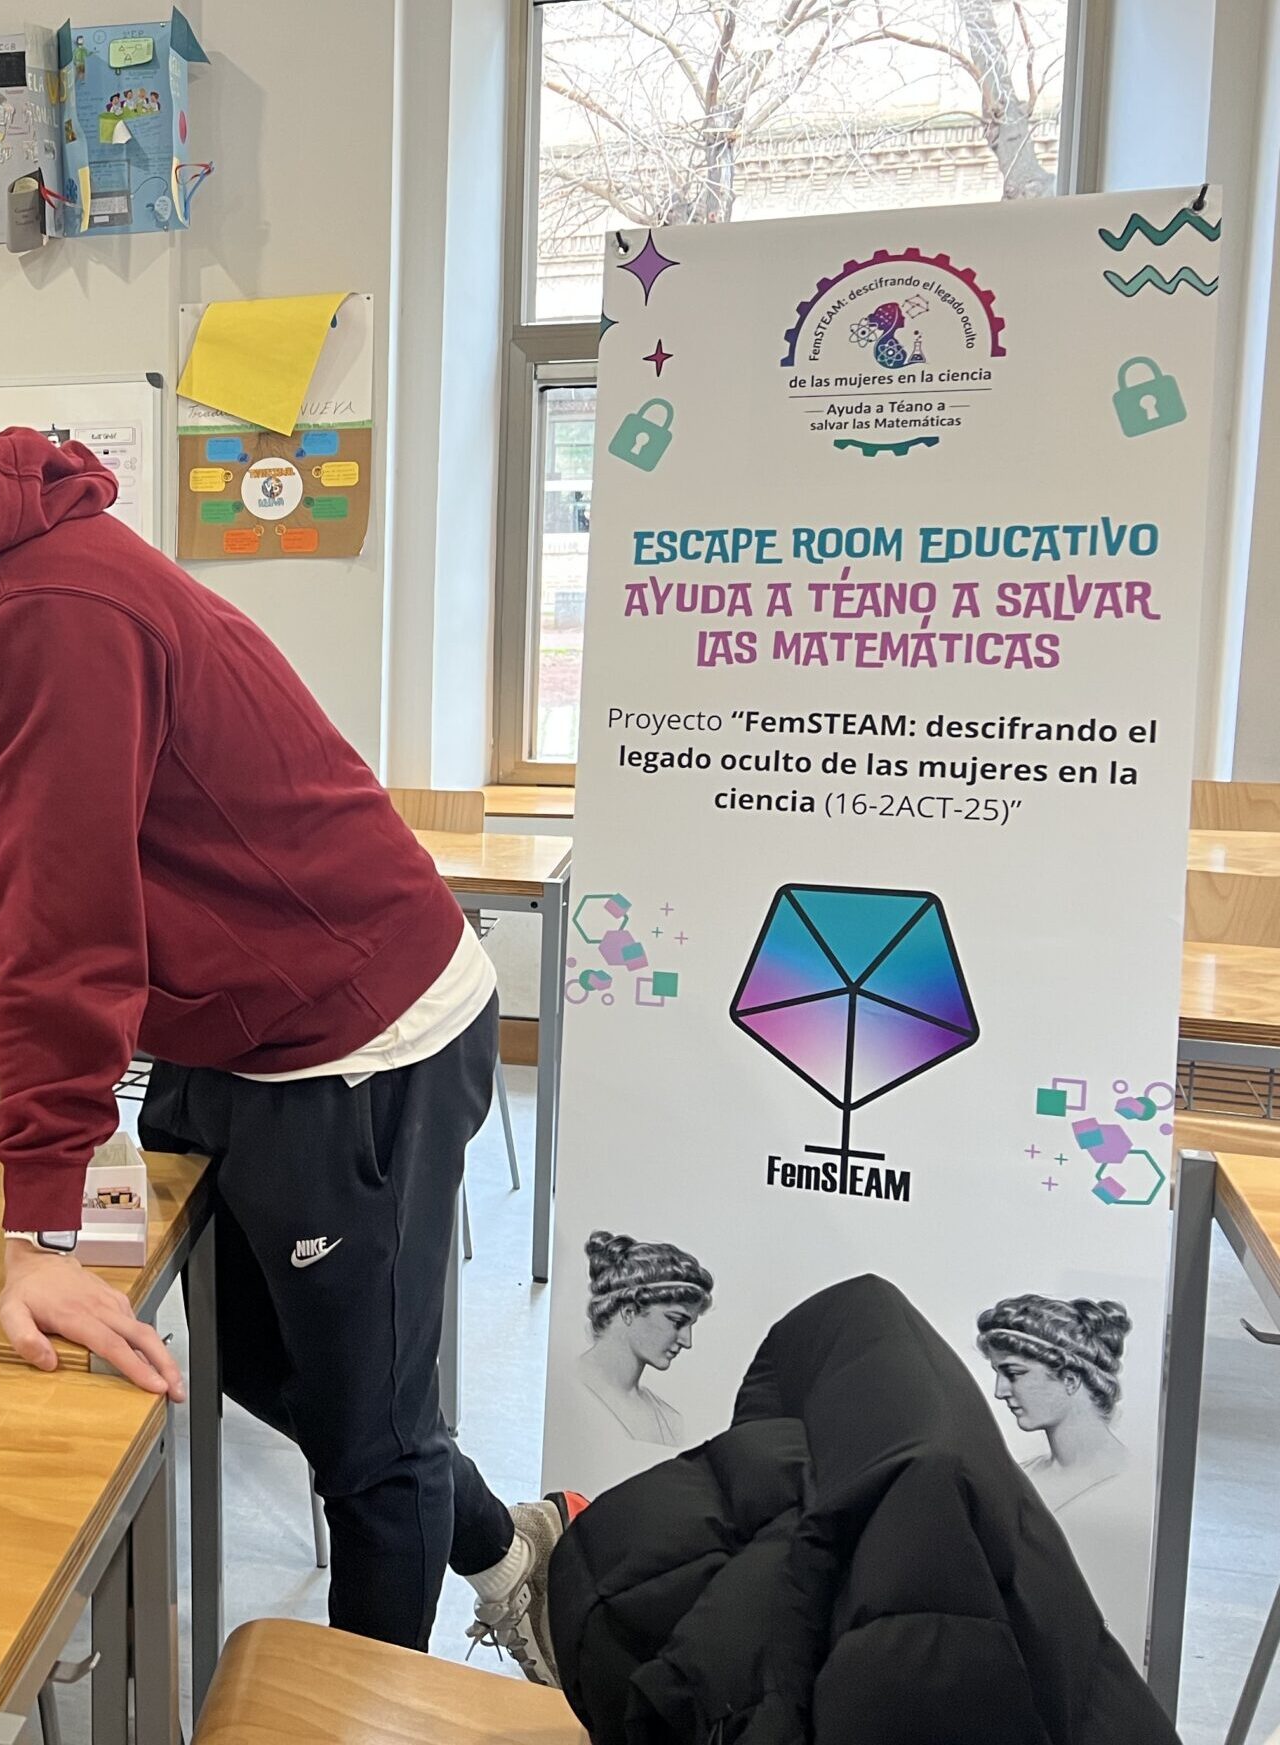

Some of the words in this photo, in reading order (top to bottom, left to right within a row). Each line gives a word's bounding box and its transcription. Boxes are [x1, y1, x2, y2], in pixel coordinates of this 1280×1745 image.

[808, 298, 849, 362] FemSTEAM:
[849, 275, 920, 301] descifrando
[922, 281, 934, 291] el
[934, 284, 964, 315] legado
[960, 315, 978, 349] oculto
[789, 376, 807, 389] de
[810, 375, 830, 388] las
[834, 374, 894, 389] mujeres
[898, 372, 917, 384] en
[921, 370, 934, 383] la
[938, 367, 992, 383] ciencia
[810, 418, 849, 431] salvar
[852, 418, 871, 430] las
[874, 414, 962, 429] Matemáticas
[826, 402, 871, 418] Ayuda
[875, 404, 884, 414] a
[888, 399, 933, 413] Téano
[937, 402, 946, 412] a
[633, 528, 783, 565] ESCAPE
[792, 527, 903, 564] ROOM
[919, 516, 1159, 563] EDUCATIVO
[624, 576, 753, 617] AYUDA
[766, 582, 793, 618] A
[808, 566, 937, 619] TÉANO
[951, 582, 981, 618] A
[995, 574, 1161, 621] SALVAR
[697, 630, 757, 667] LAS
[772, 614, 1061, 669] MATEMÁTICAS
[608, 707, 723, 736] Proyecto
[731, 710, 917, 737] “FemSTEAM:
[926, 714, 1118, 743] descifrando
[1128, 719, 1157, 744] el
[619, 745, 712, 774] legado
[720, 749, 812, 773] oculto
[821, 752, 857, 775] de
[867, 752, 909, 777] las
[918, 756, 1048, 786] mujeres
[1058, 764, 1098, 784] en
[1109, 760, 1138, 785] la
[714, 787, 816, 813] ciencia
[825, 791, 1022, 826] (16-2ACT-25)”
[766, 1146, 912, 1202] FemSTEAM
[295, 1236, 328, 1257] NIKE
